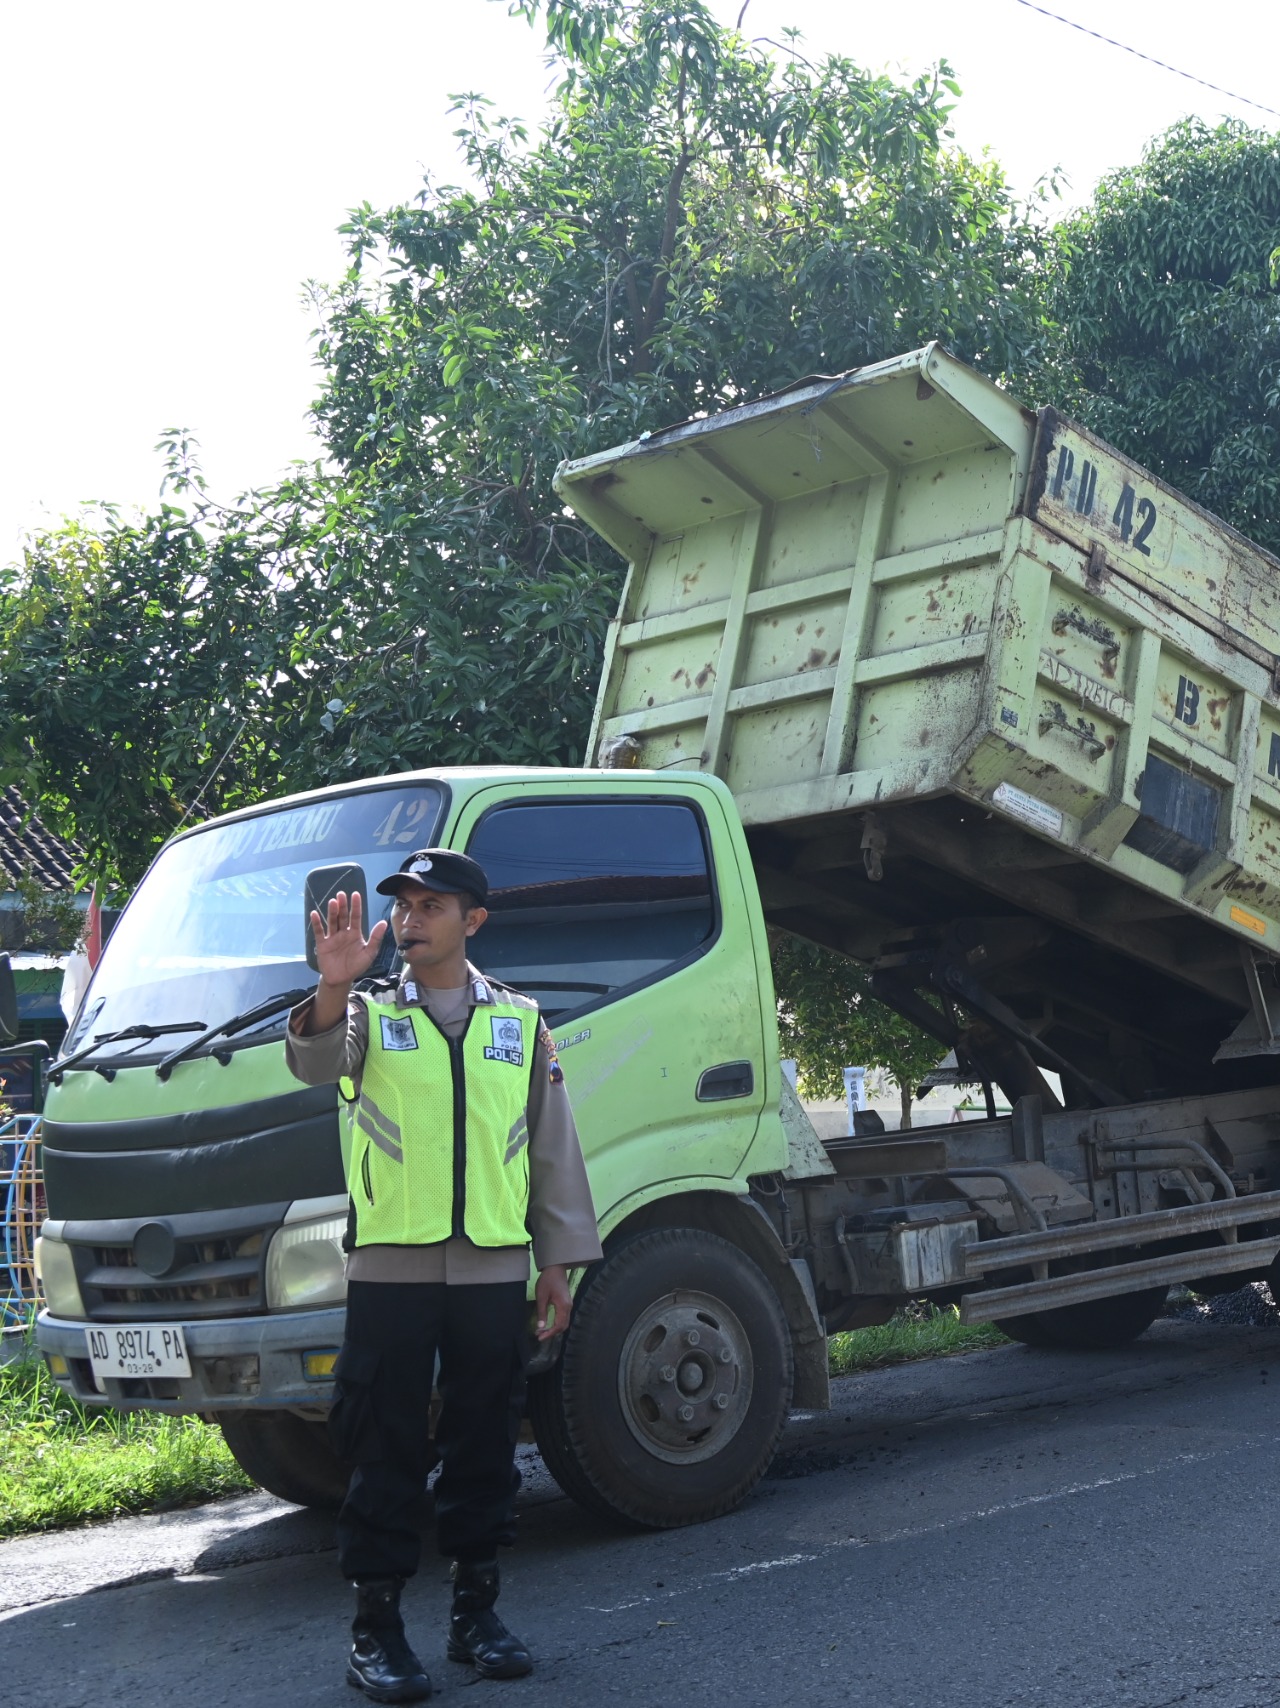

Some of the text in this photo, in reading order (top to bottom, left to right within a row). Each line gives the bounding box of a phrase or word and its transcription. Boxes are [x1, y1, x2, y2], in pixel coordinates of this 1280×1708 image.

[1112, 482, 1157, 558] 42
[1174, 674, 1200, 727] B
[252, 803, 344, 855] TEKMU
[372, 798, 429, 847] 42
[486, 1047, 523, 1067] POLISI
[554, 1028, 592, 1052] OLER
[90, 1330, 184, 1360] AD 8974 PA
[127, 1363, 155, 1374] 03-28
